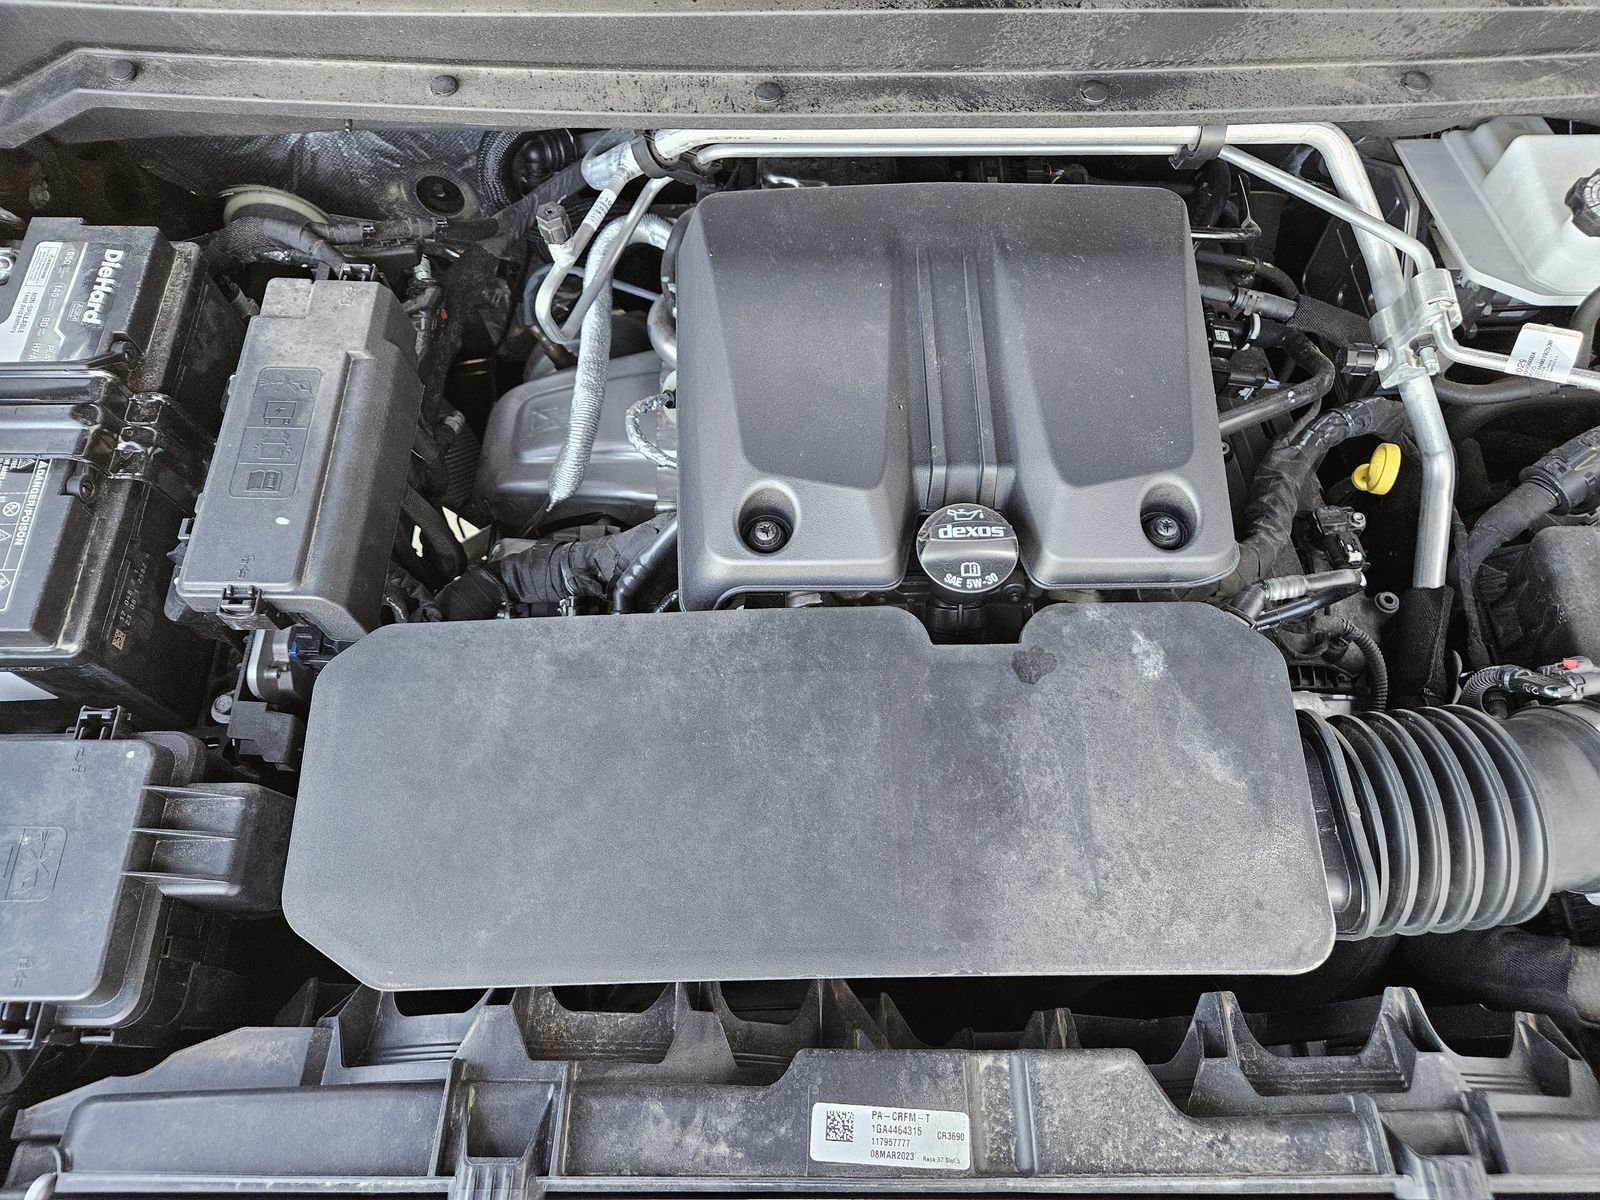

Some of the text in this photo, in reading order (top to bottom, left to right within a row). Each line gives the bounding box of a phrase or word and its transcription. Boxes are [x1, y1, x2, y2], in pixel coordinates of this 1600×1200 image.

[51, 284, 63, 298] 140
[81, 249, 124, 325] DieHard
[16, 292, 38, 334] NON-SPILLABLE
[14, 469, 44, 546] DANGER/POISON
[938, 525, 1005, 538] dexos
[944, 573, 998, 588] SAE 5W-30
[871, 1124, 922, 1136] 1GA4464315
[937, 1131, 965, 1141] CR3690
[871, 1137, 911, 1148] 117957777
[870, 1149, 915, 1161] 08MAR2023
